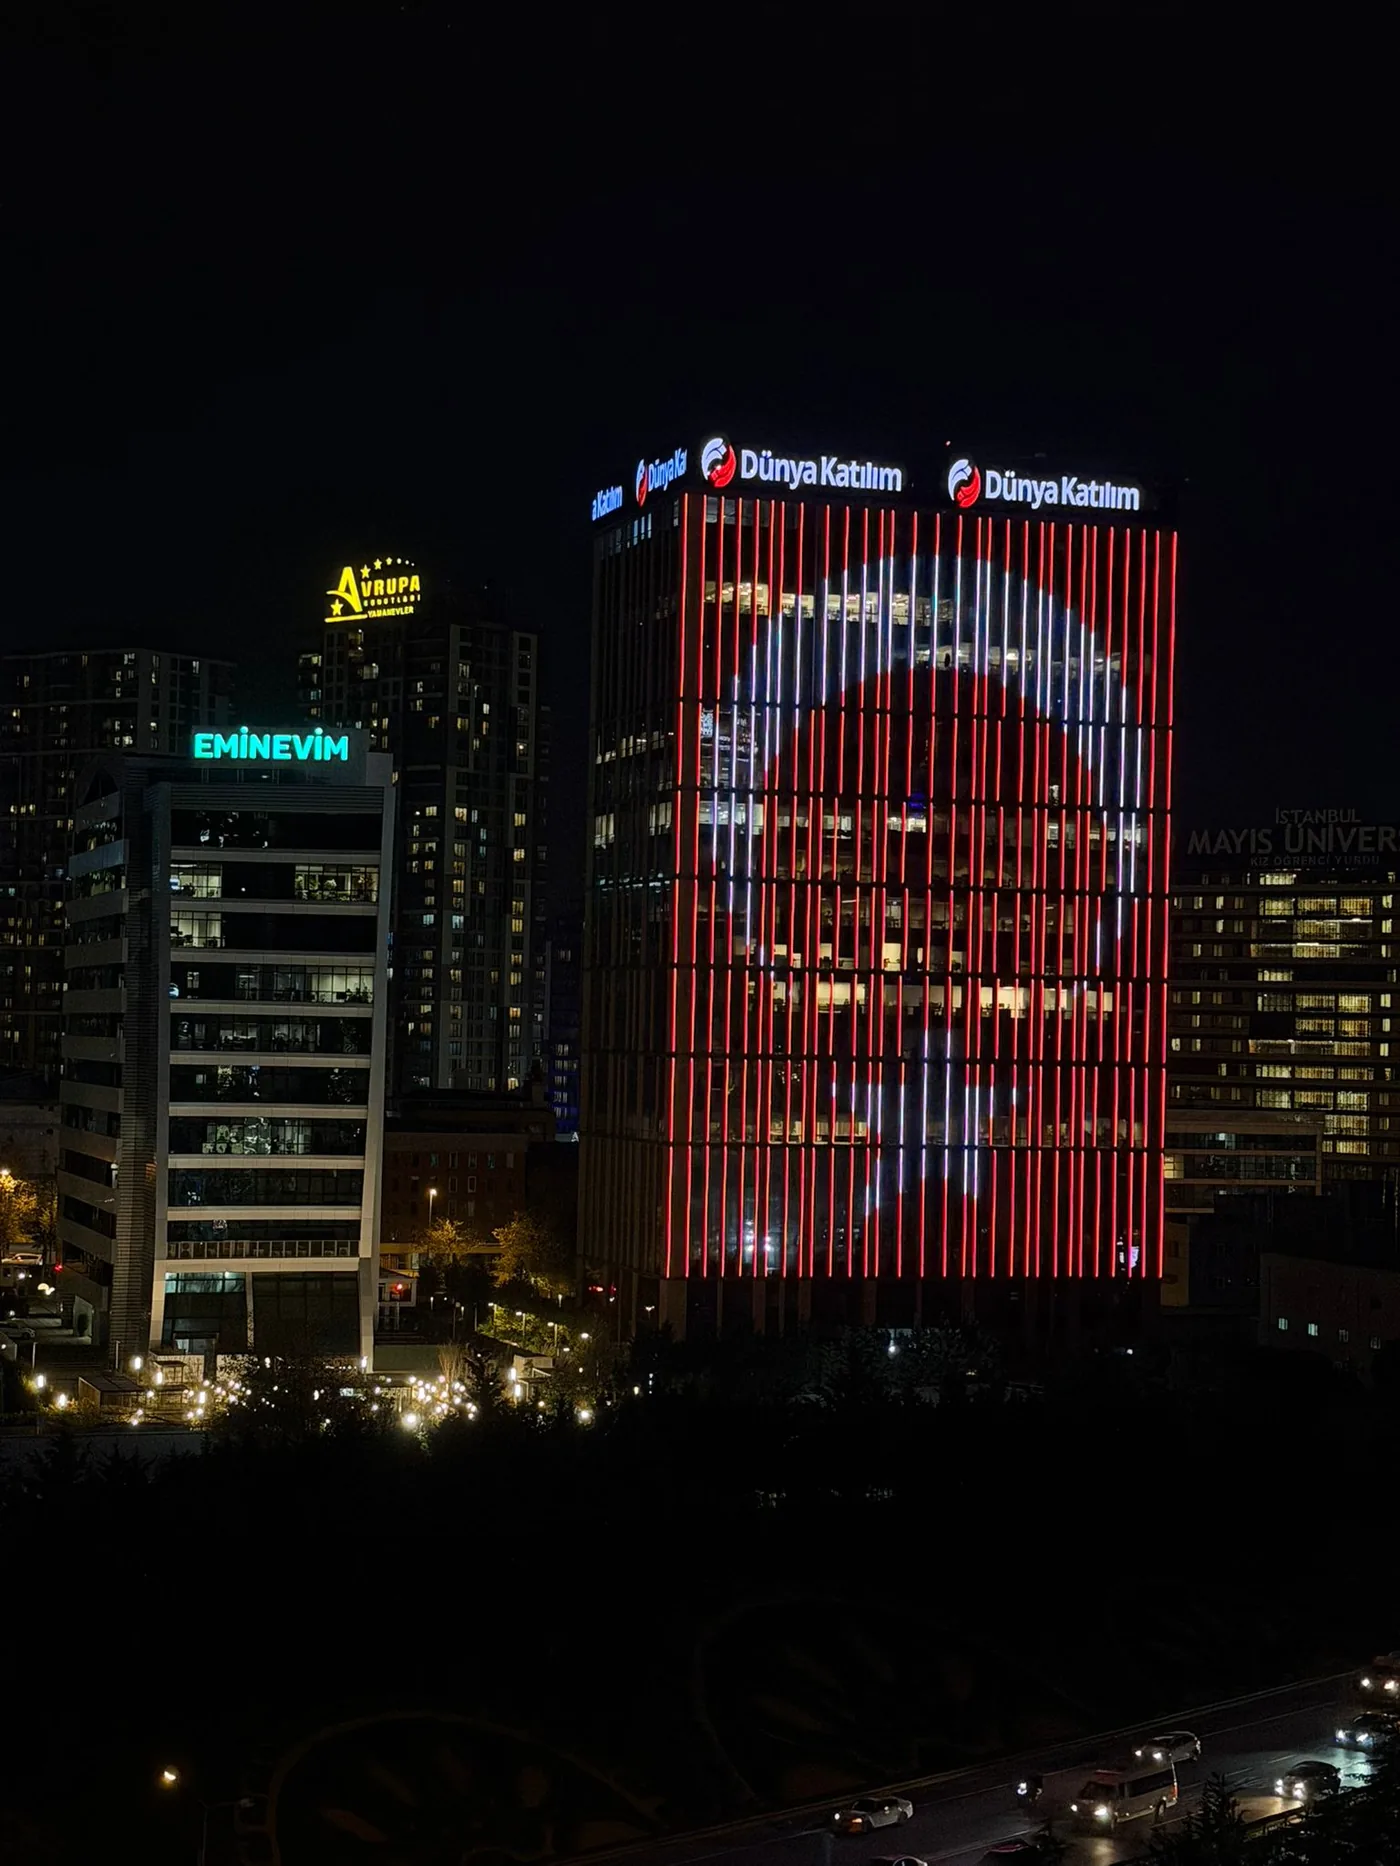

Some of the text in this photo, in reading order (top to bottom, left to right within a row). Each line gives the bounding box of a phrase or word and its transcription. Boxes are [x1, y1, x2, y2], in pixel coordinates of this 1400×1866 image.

[648, 458, 674, 492] Dünya
[741, 450, 902, 491] Dünya Katılım
[985, 469, 1140, 511] Dünya Katılım
[326, 566, 421, 613] AVRUPA
[194, 726, 349, 761] EMİNEVİM
[1187, 823, 1400, 855] MAYIS ÜNİVER
